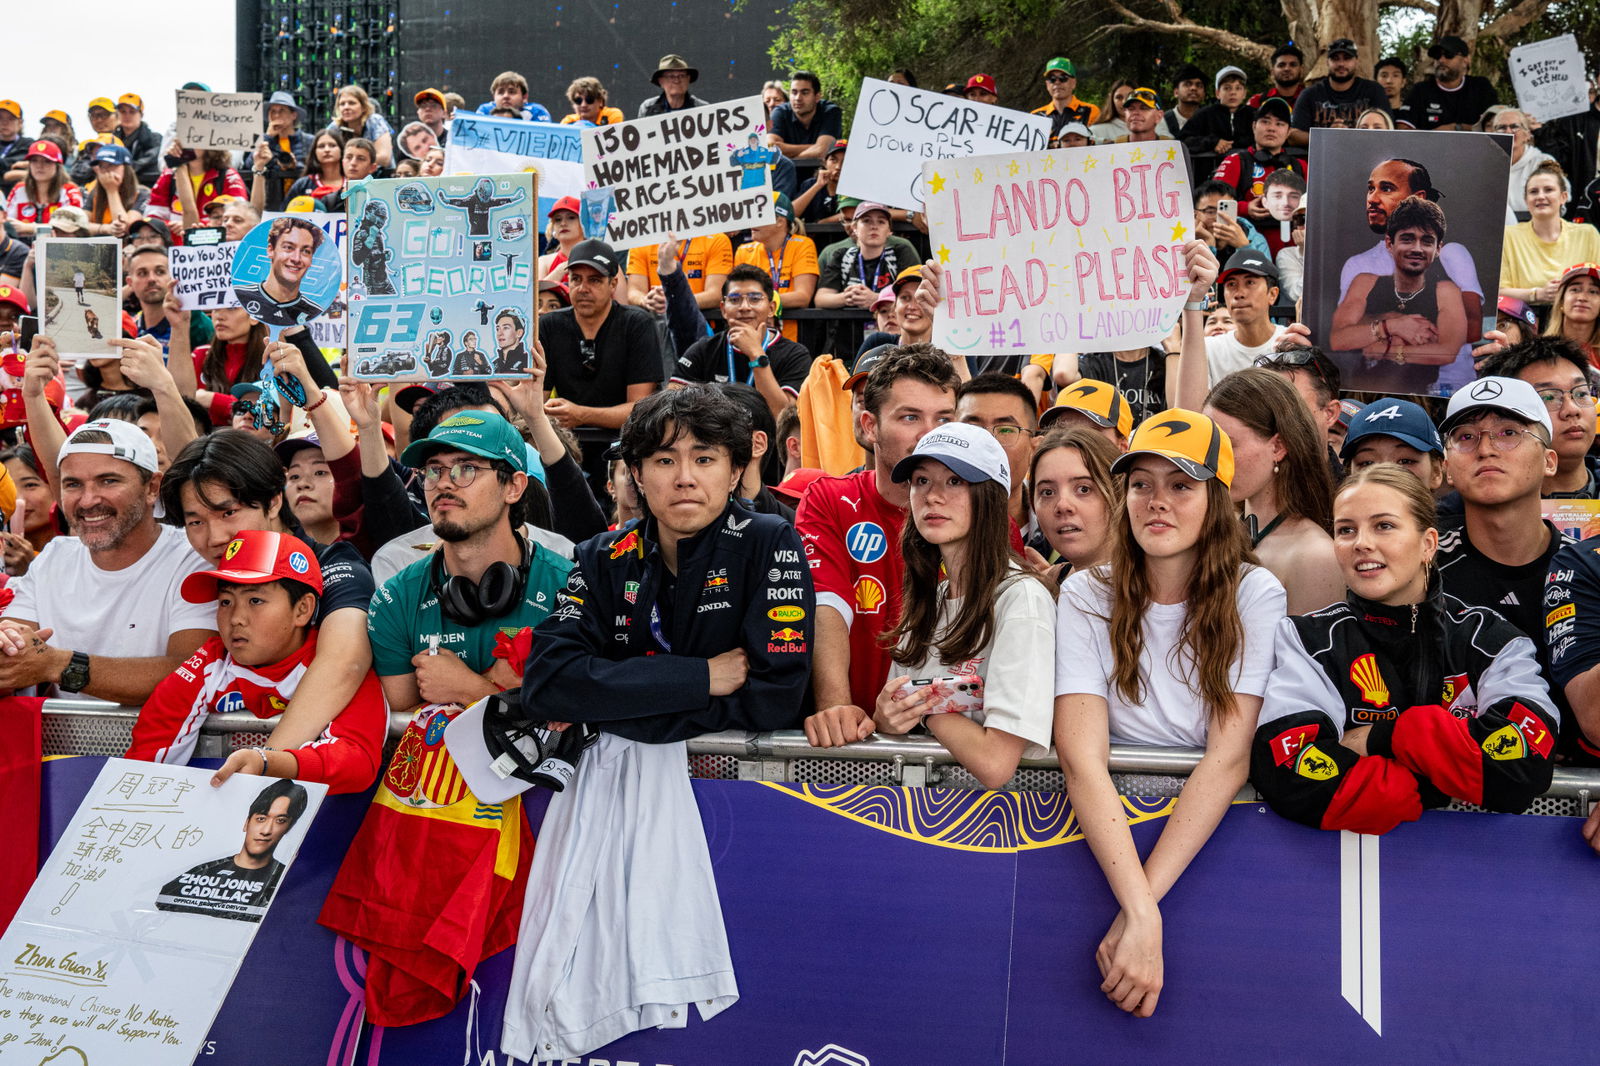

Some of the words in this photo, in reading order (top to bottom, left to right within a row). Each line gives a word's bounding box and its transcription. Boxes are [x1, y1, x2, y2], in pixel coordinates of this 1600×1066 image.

[1551, 74, 1568, 82] HEAD
[177, 91, 206, 105] From
[210, 94, 261, 111] Germany
[192, 109, 255, 123] Melbourne
[869, 89, 978, 135] OSCAR
[985, 115, 1047, 151] HEAD
[186, 126, 204, 143] for
[209, 129, 260, 149] Lando!
[866, 132, 914, 153] Drove
[920, 142, 933, 158] 13
[593, 142, 720, 187] HOMEMADE
[953, 178, 1090, 241] LANDO
[1113, 161, 1180, 223] BIG
[607, 210, 672, 242] WORTH
[676, 208, 690, 231] A
[693, 194, 768, 227] SHOUT?
[197, 249, 216, 262] You
[401, 262, 529, 296] GEORGE
[945, 258, 1049, 319] HEAD
[1074, 245, 1188, 305] PLEASE
[353, 303, 427, 344] 63
[989, 318, 1026, 348] #1
[1040, 313, 1068, 343] GO
[1078, 307, 1163, 340] LANDO!!!
[466, 430, 482, 439] TEAM
[851, 523, 880, 562] hp
[292, 553, 307, 571] hp
[774, 550, 800, 563] VISA
[706, 568, 727, 578] CLE
[782, 570, 802, 580] AT&T
[701, 586, 730, 596] ING
[767, 587, 804, 600] ROKT
[697, 601, 732, 613] ONDA
[778, 609, 802, 617] RAUCH
[419, 632, 465, 644] MDEN
[1519, 716, 1547, 744] F-1
[1281, 732, 1306, 756] F-1
[106, 772, 196, 803] 周冠宇
[81, 816, 204, 849] 全中国人的
[178, 873, 221, 887] ZHOU
[219, 878, 264, 893] JOINS
[180, 885, 252, 903] CADILLAC
[173, 897, 198, 906] OFFICIAL
[225, 904, 248, 912] DRIVER
[14, 943, 56, 969] Zhou
[58, 951, 92, 975] Guan
[93, 959, 108, 980] Yu
[15, 987, 76, 1009] international
[80, 996, 121, 1016] Chinese
[124, 1003, 143, 1022] No
[143, 1009, 180, 1029] Matter
[19, 1005, 44, 1029] they
[49, 1015, 68, 1025] are
[72, 1014, 98, 1028] will
[96, 1018, 118, 1031] all
[116, 1022, 160, 1042] Support
